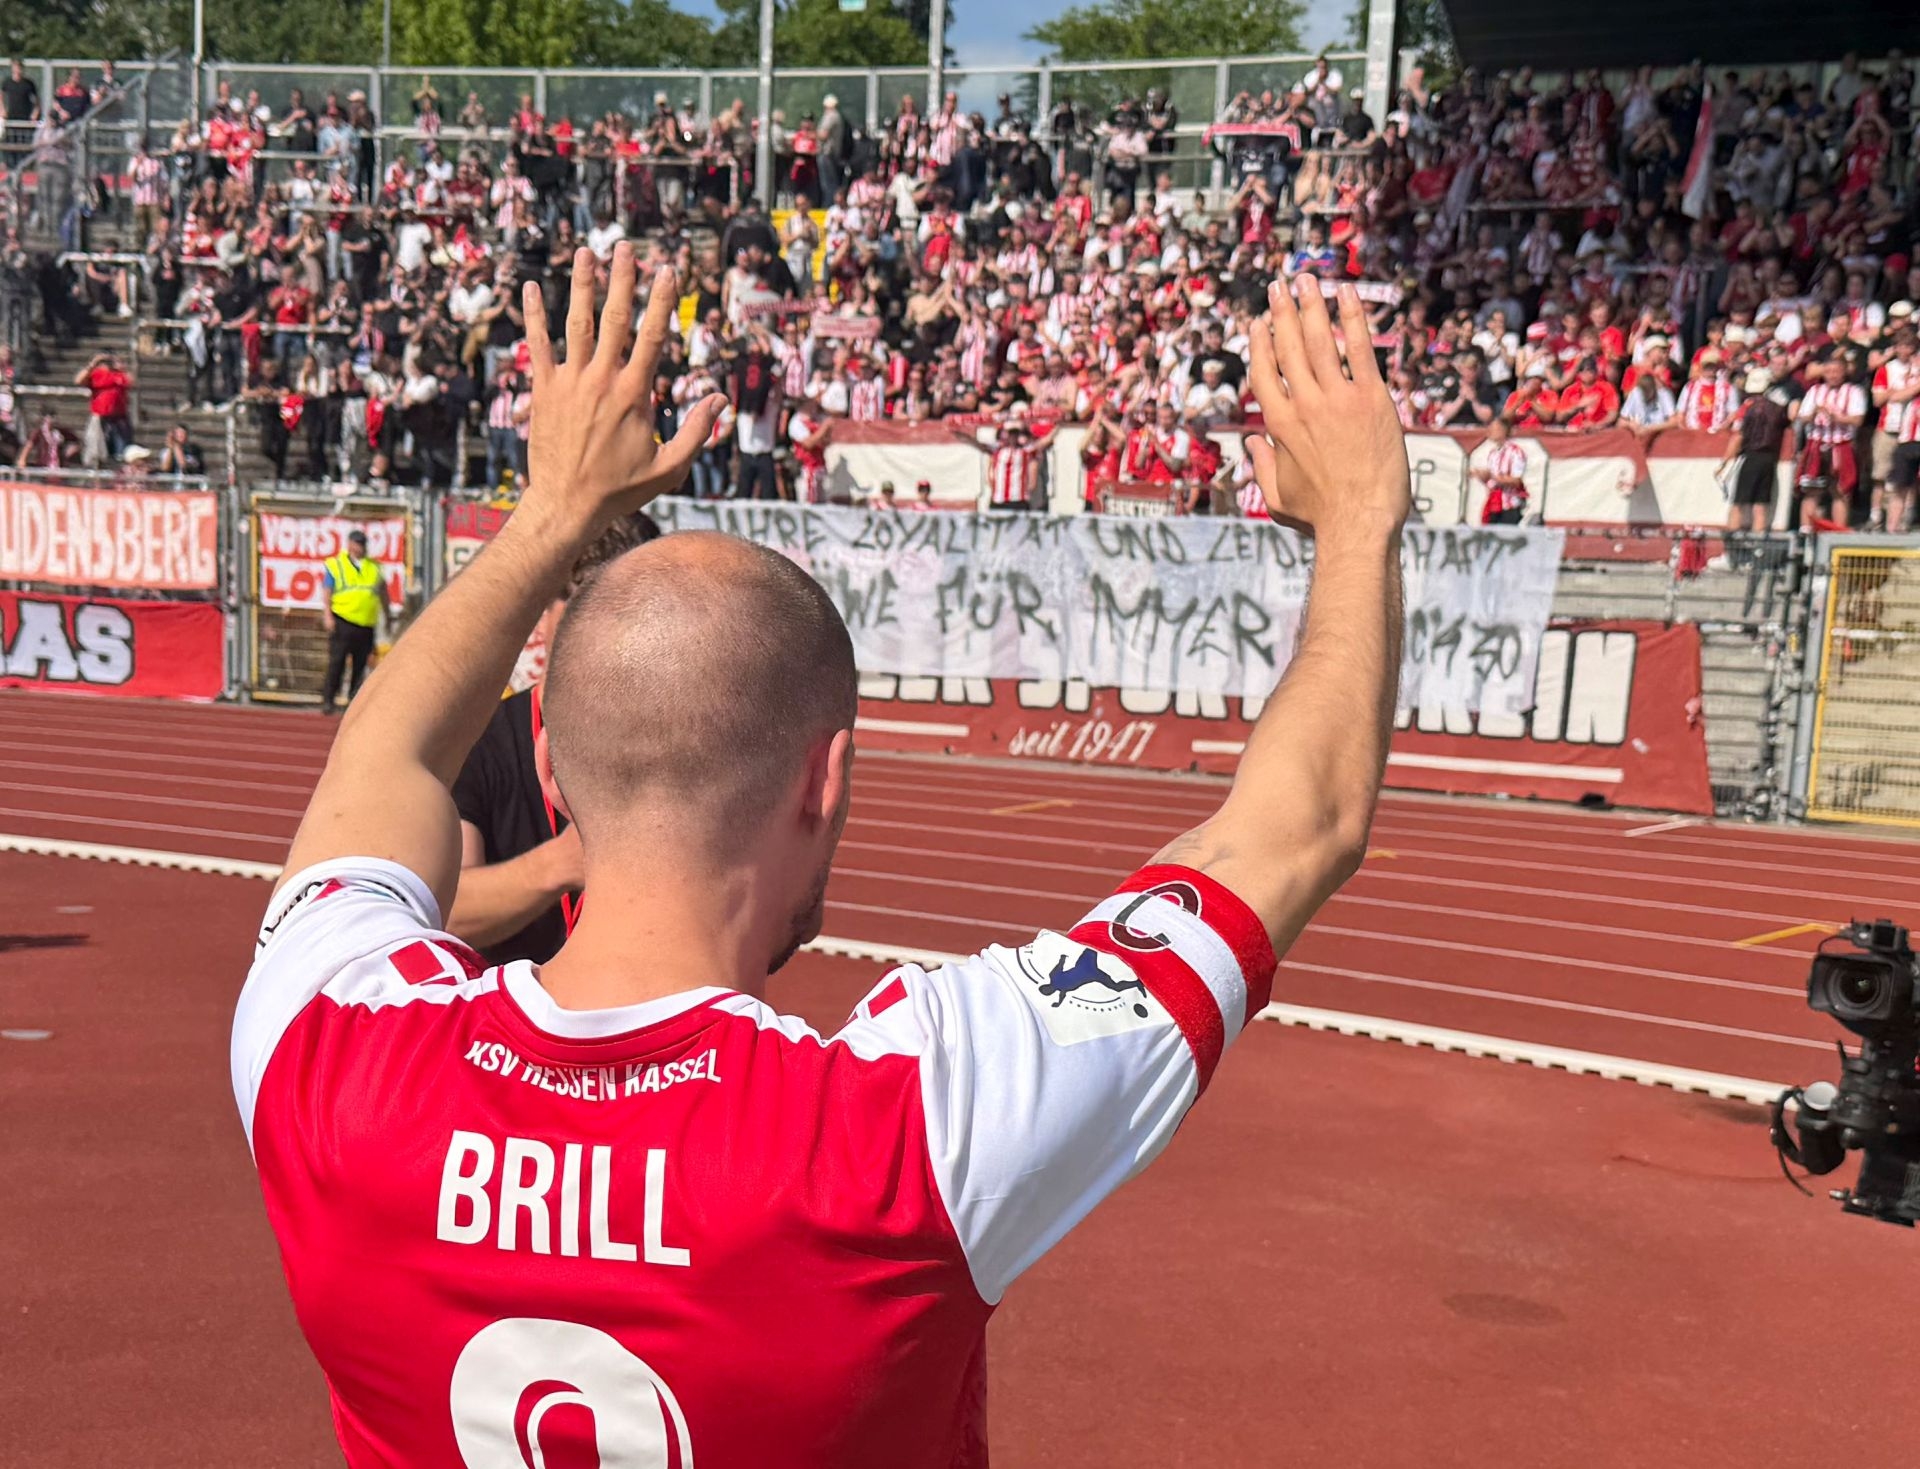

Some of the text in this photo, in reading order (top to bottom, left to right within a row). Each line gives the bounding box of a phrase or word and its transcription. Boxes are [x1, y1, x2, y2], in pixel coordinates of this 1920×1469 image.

[261, 515, 405, 561] VORSTDT
[1088, 517, 1187, 565] UND
[934, 565, 1057, 643] FÜR
[0, 599, 134, 685] AS
[464, 1040, 520, 1077] KSV
[624, 1048, 722, 1097] KASSEL
[436, 1129, 691, 1267] BRILL
